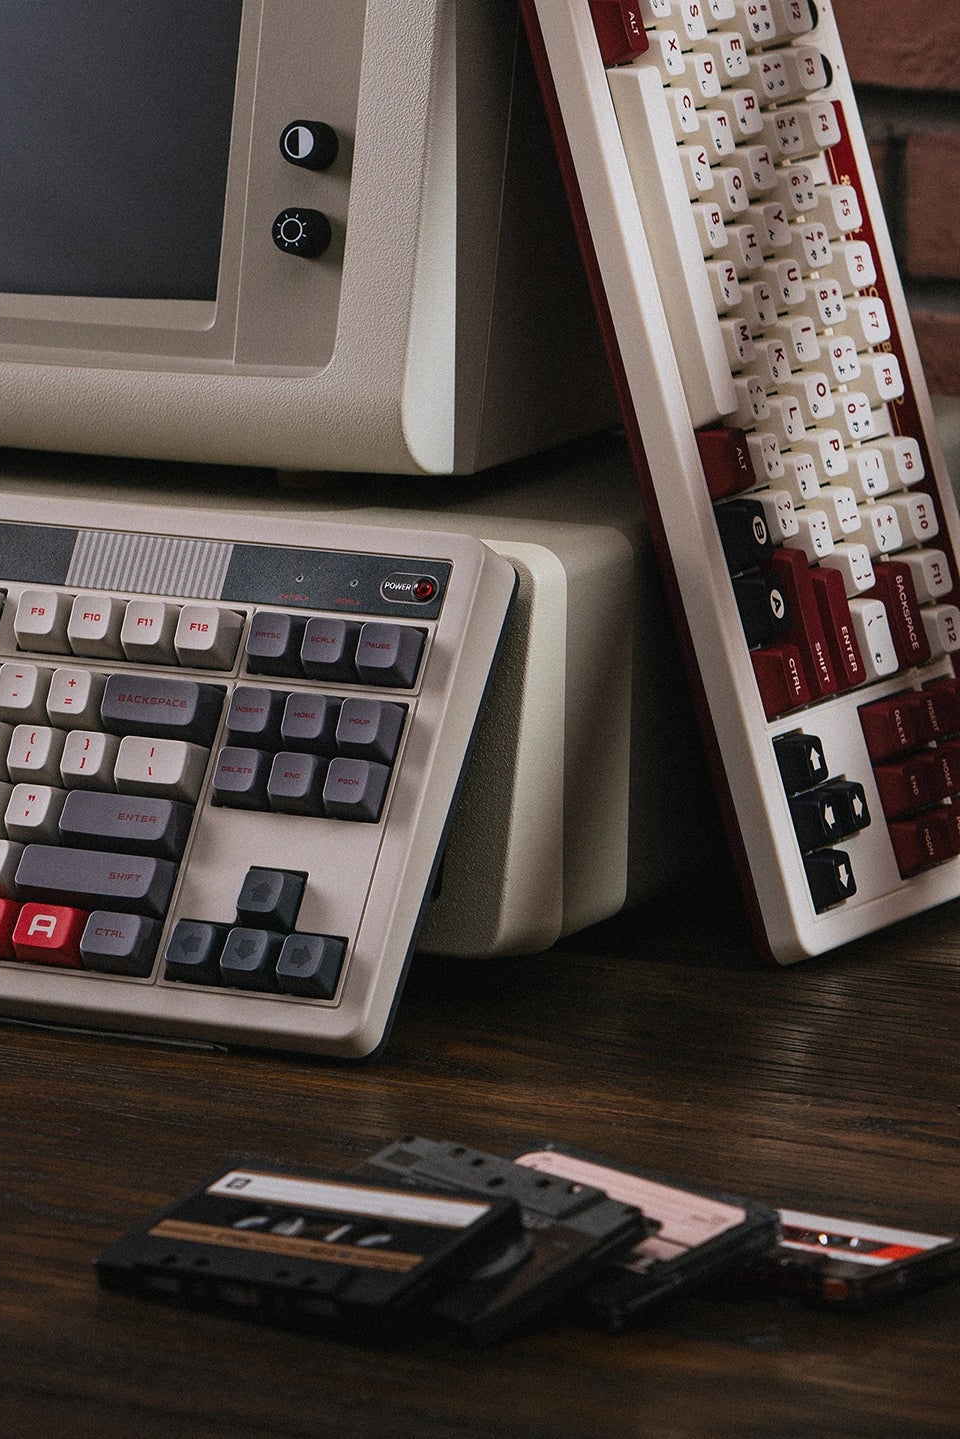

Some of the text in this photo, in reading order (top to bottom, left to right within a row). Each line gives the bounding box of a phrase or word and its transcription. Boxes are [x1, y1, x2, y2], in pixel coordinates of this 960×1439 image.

[790, 2, 802, 20] F2
[627, 11, 640, 37] ALT
[803, 57, 815, 76] F3
[817, 113, 829, 133] F4
[840, 198, 851, 217] F5
[853, 254, 865, 273] F6
[867, 310, 880, 329] F7
[881, 366, 893, 387] F8
[736, 447, 748, 471] ALT
[901, 451, 914, 471] F9
[915, 503, 929, 530] F10
[930, 563, 943, 586] F11
[384, 581, 411, 591] POWER
[30, 606, 46, 617] F9
[82, 612, 101, 623] F10
[895, 574, 921, 651] BACKSPACE
[136, 616, 154, 627] F11
[189, 621, 209, 633] F12
[944, 616, 958, 643] F12
[255, 631, 282, 639] PRTSC
[365, 641, 391, 650] PAUSE
[841, 626, 858, 673] ENTER
[815, 641, 830, 683] SHIFT
[789, 657, 802, 696] CTRL
[117, 692, 188, 709] BACKSPACE
[235, 706, 264, 715] INSERT
[293, 711, 316, 720] HOME
[894, 709, 908, 745] DELETE
[221, 765, 253, 775] DELETE
[284, 772, 301, 780] END
[910, 775, 919, 796] END
[117, 812, 158, 825] ENTER
[108, 871, 143, 883] SHIFT
[27, 914, 57, 938] A
[95, 927, 126, 939] CTRL
